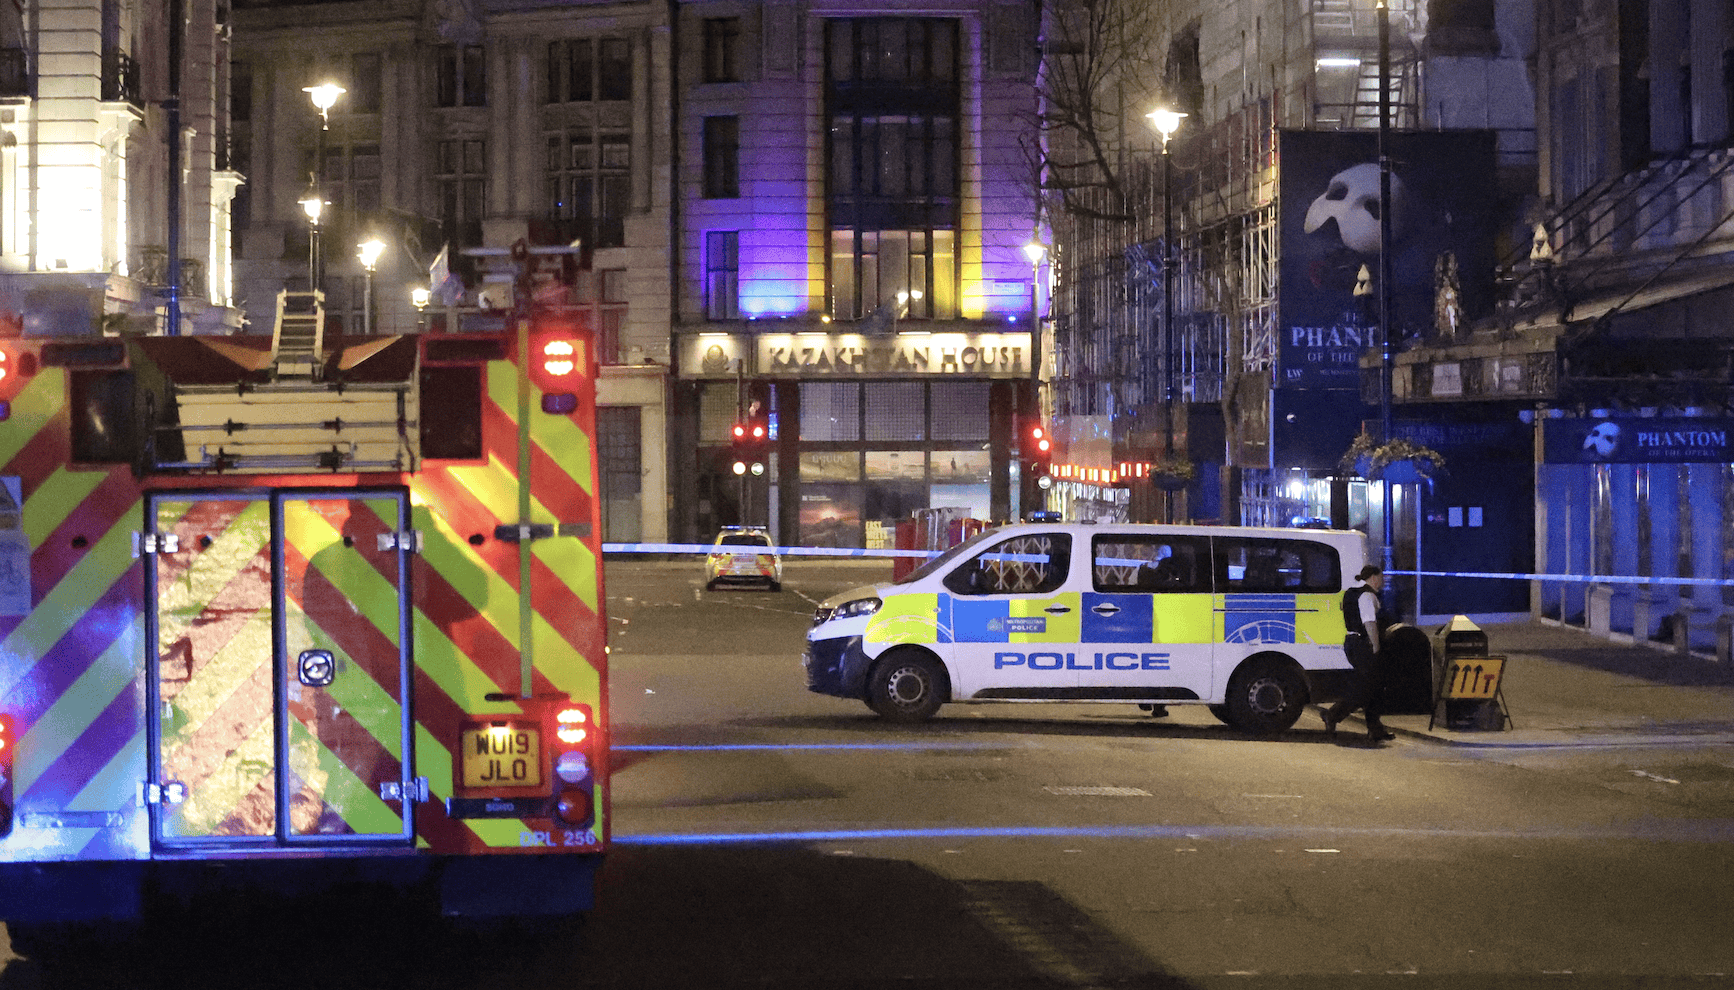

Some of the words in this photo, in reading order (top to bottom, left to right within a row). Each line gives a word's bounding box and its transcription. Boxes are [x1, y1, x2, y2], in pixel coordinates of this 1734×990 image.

[770, 347, 929, 369] KAZAKHAN
[941, 347, 1021, 368] HOUSE
[1307, 353, 1323, 361] OF
[1637, 431, 1726, 447] PHANTOM
[994, 652, 1171, 670] POLICE
[476, 733, 530, 755] WU19
[480, 759, 527, 781] JLO
[519, 831, 557, 847] DPL
[563, 830, 596, 847] 256
